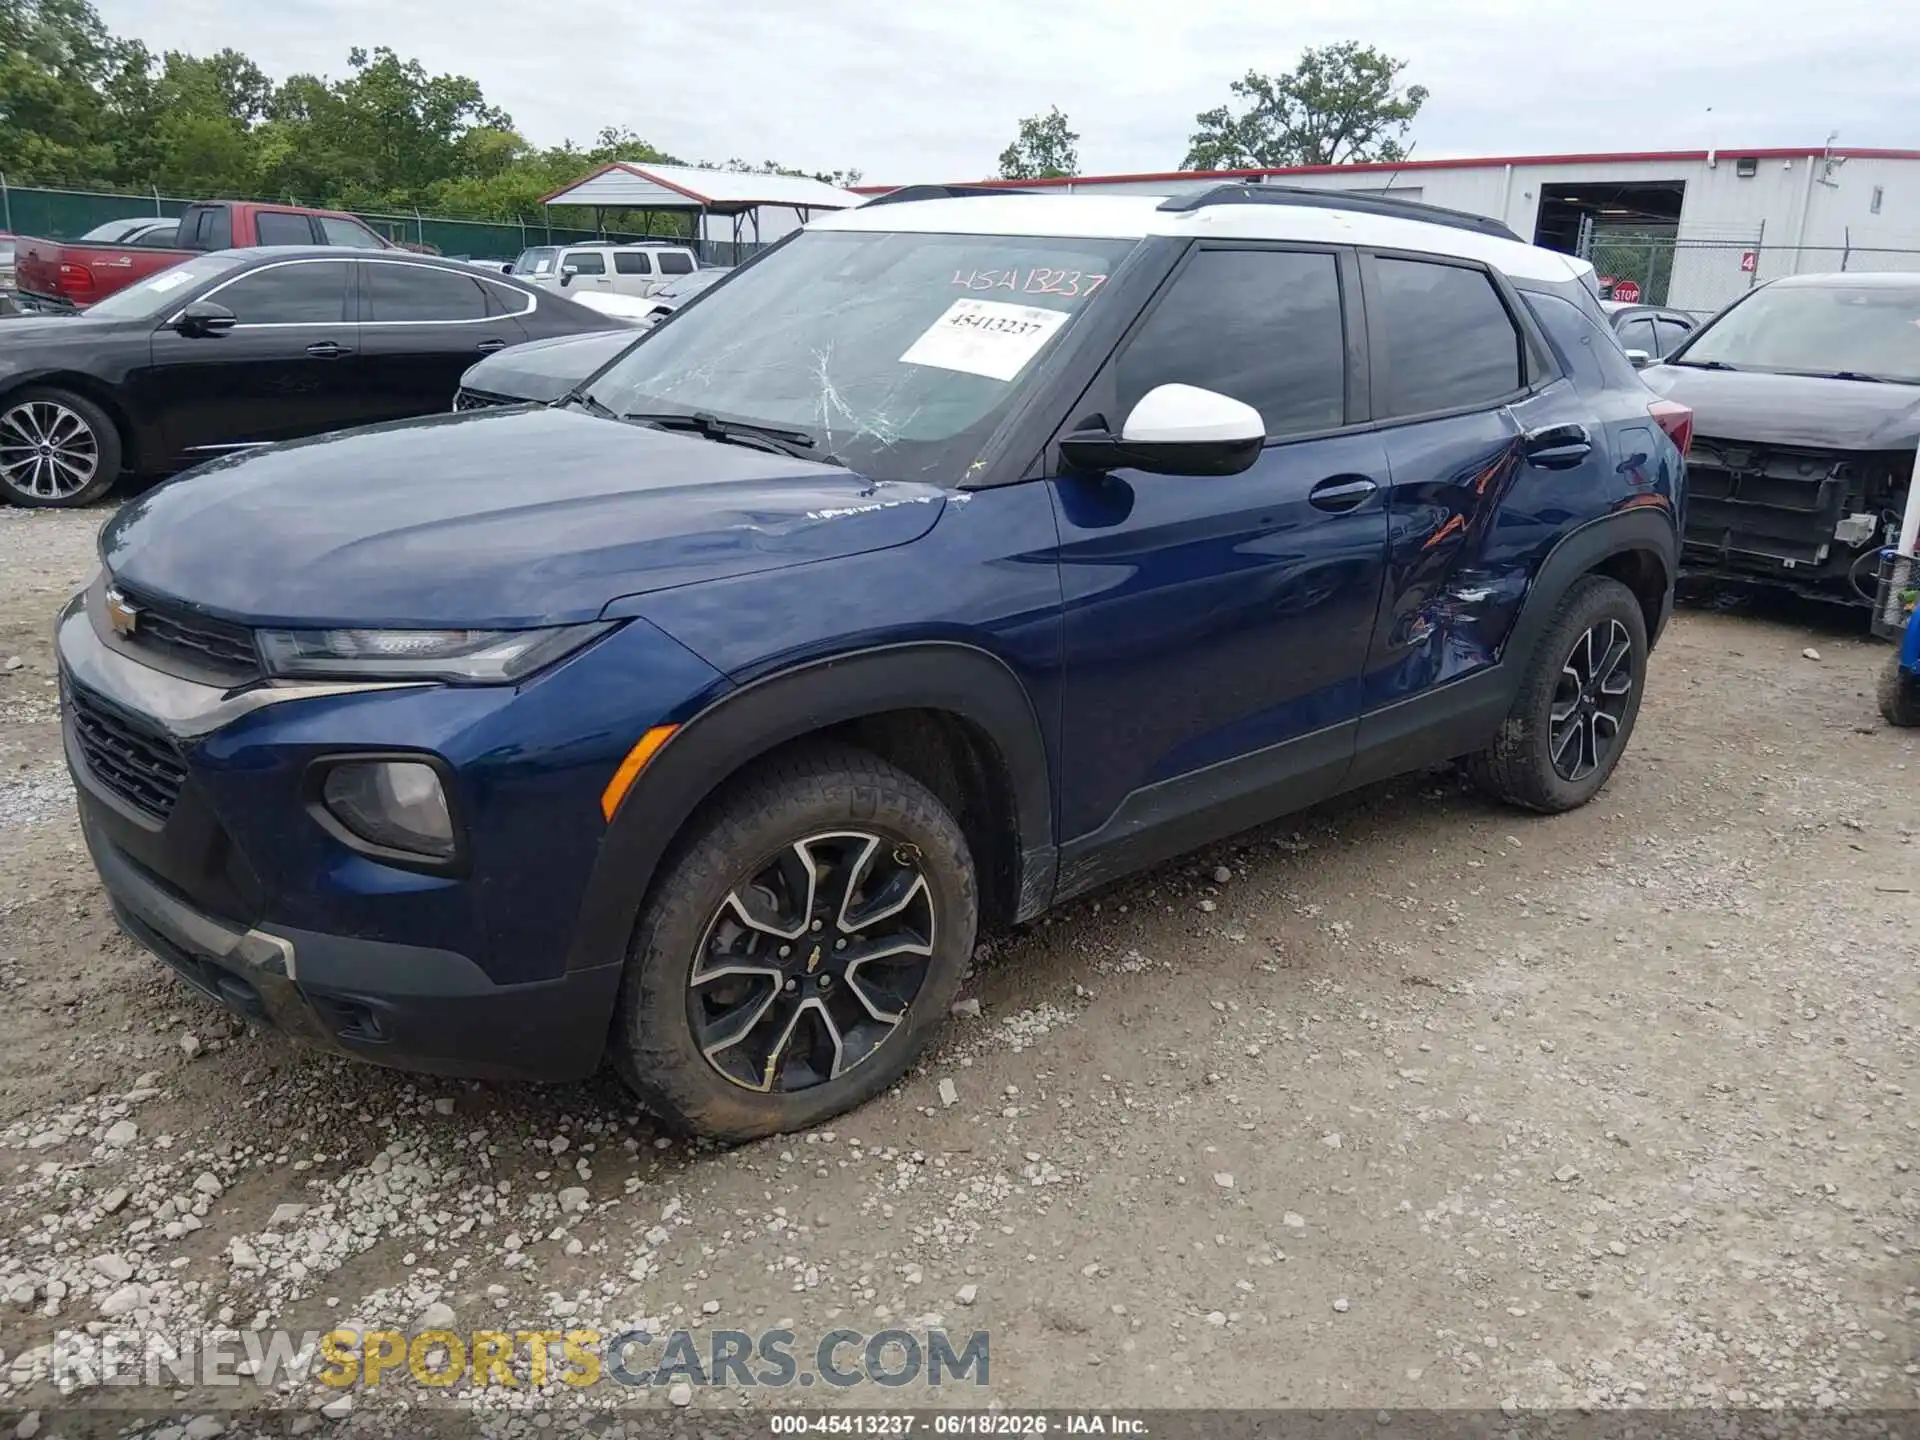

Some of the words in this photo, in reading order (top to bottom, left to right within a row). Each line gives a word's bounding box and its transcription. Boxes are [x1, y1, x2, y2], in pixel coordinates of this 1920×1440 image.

[1743, 255, 1754, 270] 4
[1615, 290, 1638, 301] STOP
[950, 314, 1042, 335] 45413237
